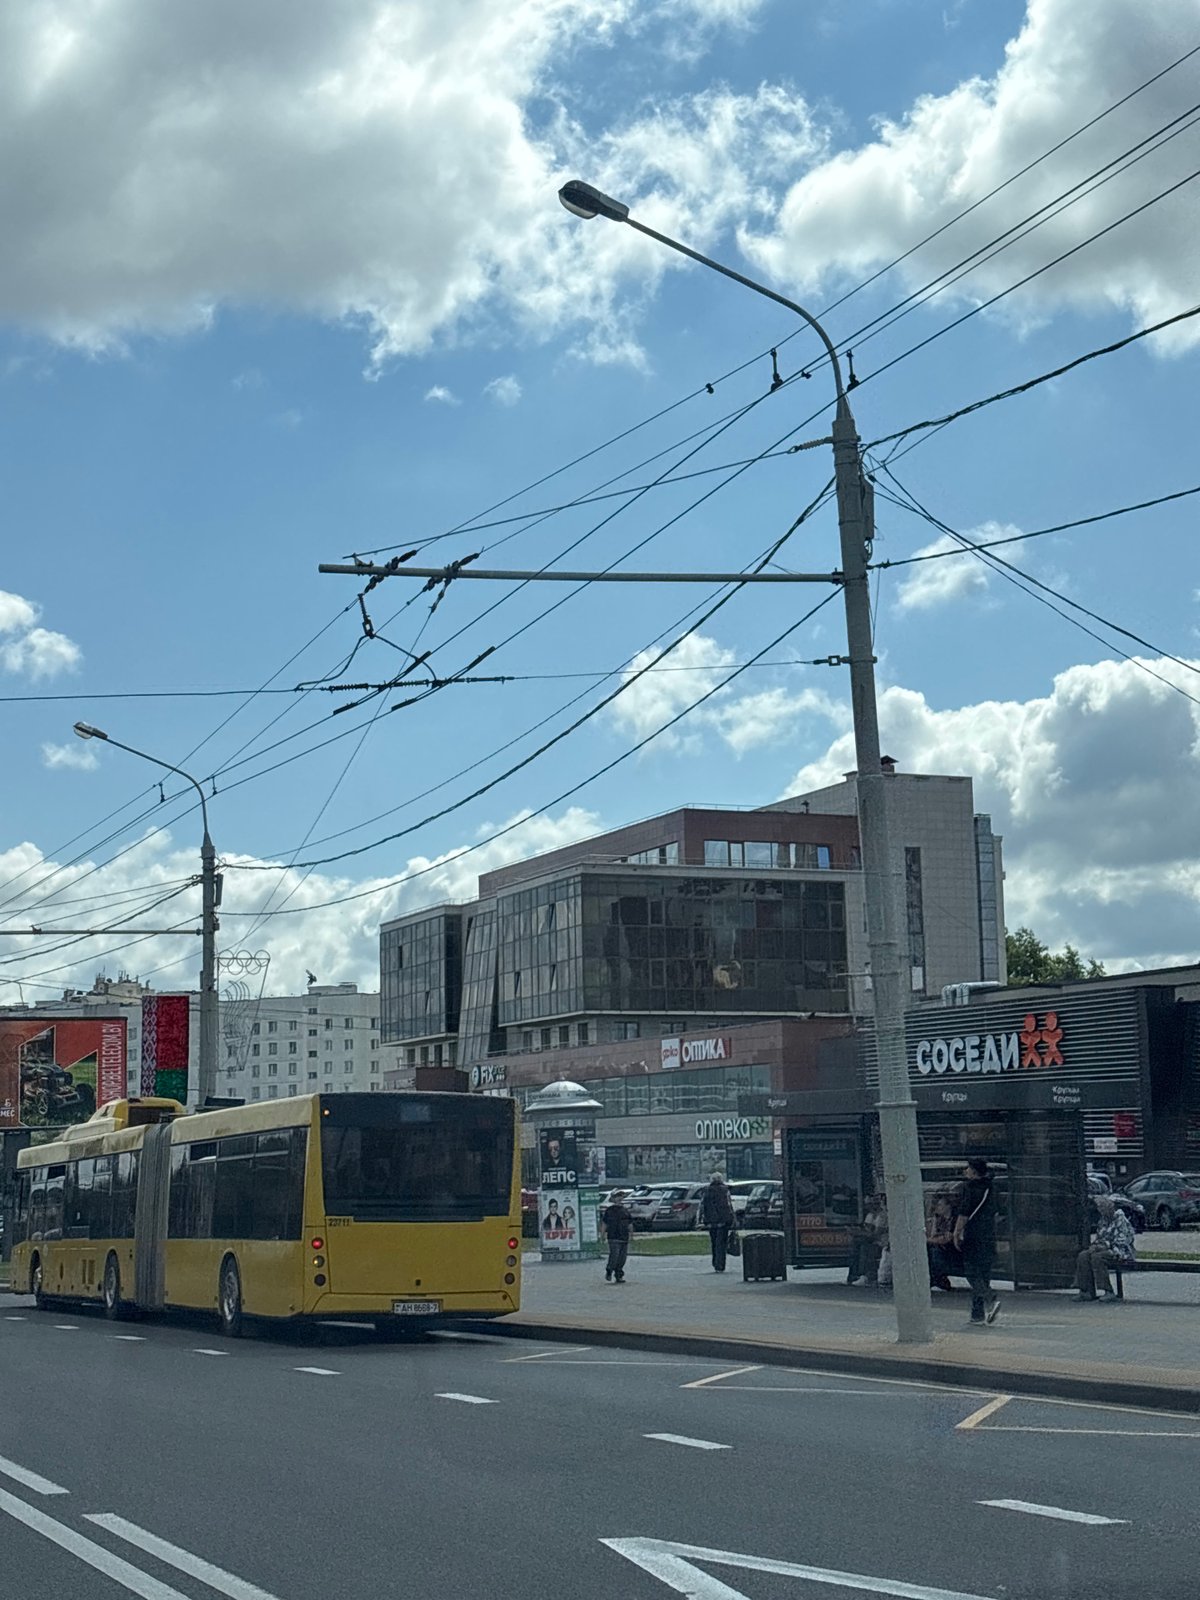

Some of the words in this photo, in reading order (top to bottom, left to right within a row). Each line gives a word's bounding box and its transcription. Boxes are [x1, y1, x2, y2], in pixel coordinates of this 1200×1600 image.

[682, 1038, 726, 1063] ОПТИКА
[916, 1032, 1019, 1074] СОСЕДИ
[695, 1118, 750, 1139] аптека
[542, 1170, 577, 1184] ЛЕПС
